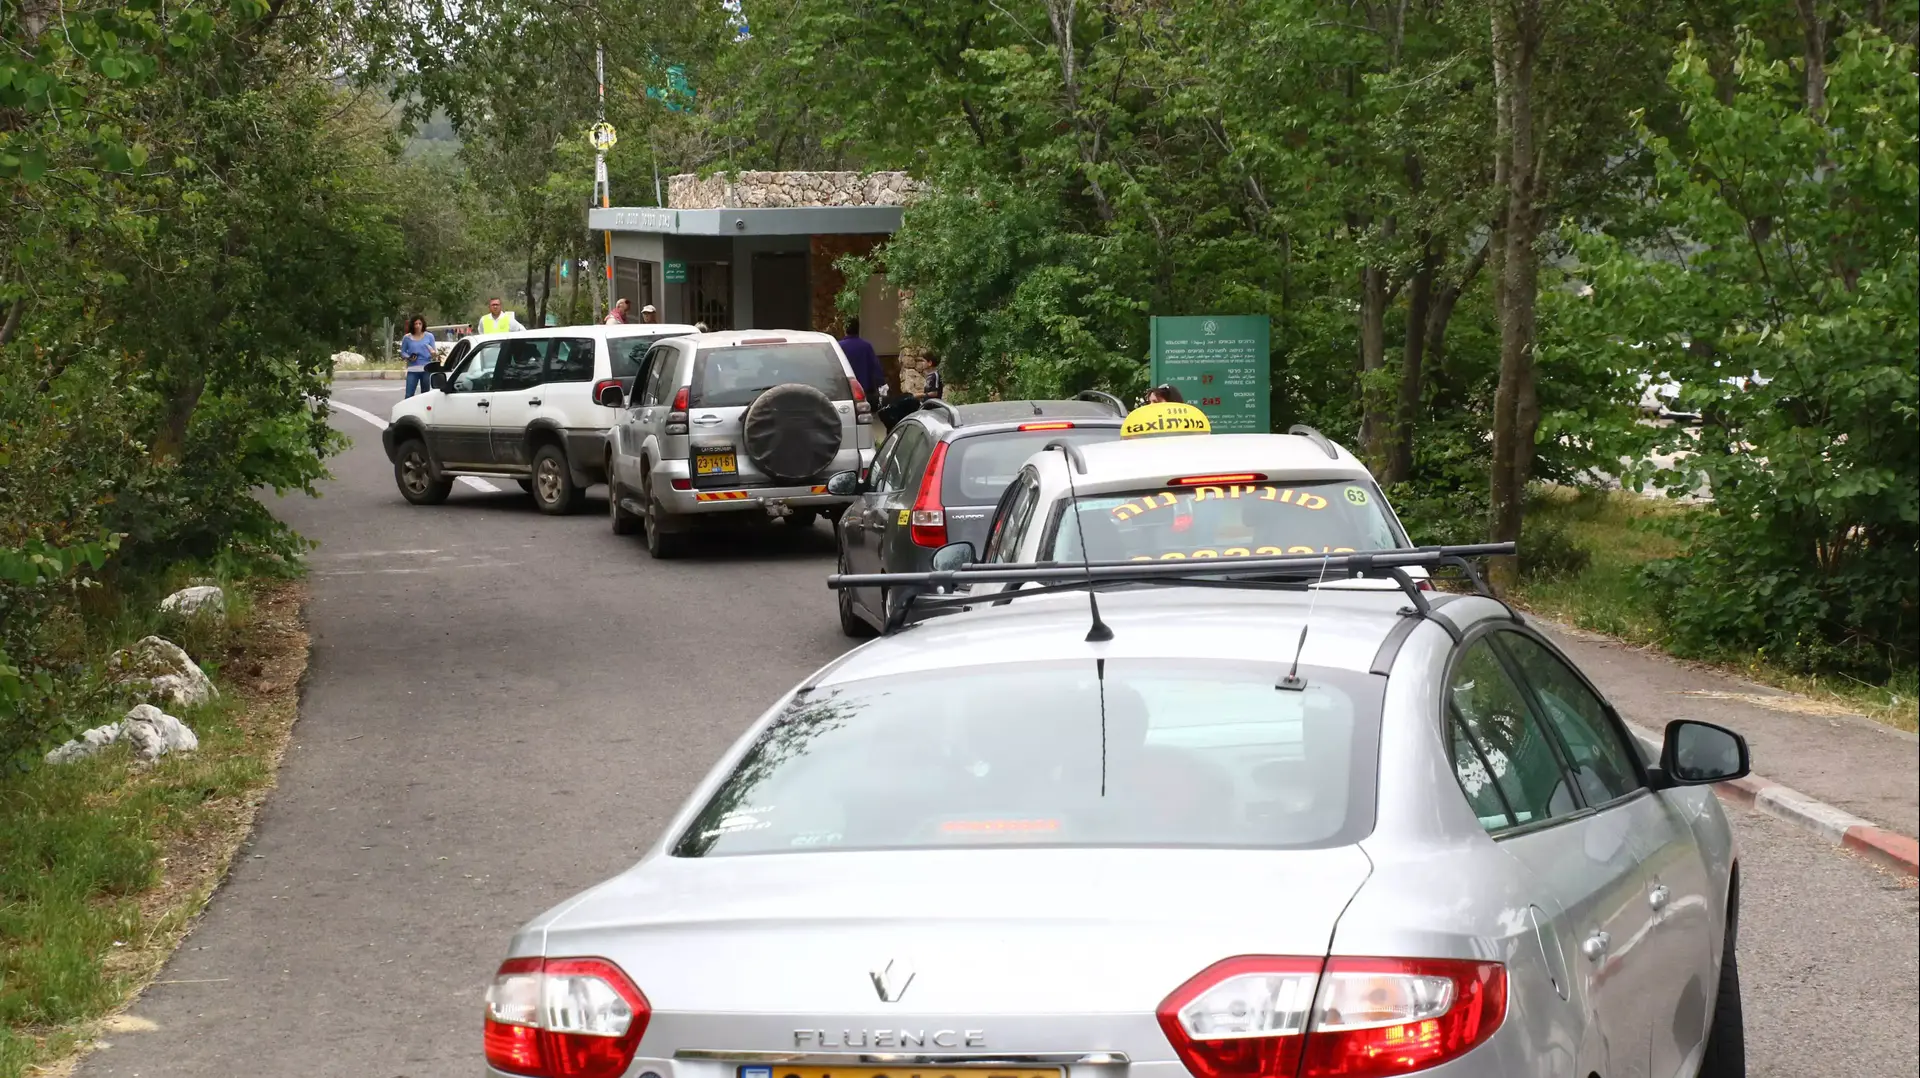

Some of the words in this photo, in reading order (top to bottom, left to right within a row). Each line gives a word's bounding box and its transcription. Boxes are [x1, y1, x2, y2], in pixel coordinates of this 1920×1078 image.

[1126, 414, 1164, 433] taxi
[1166, 418, 1204, 430] מונית
[1194, 485, 1328, 510] מוניות
[1347, 489, 1366, 503] 63
[1112, 491, 1178, 521] נוה
[793, 1029, 987, 1048] FLUENCE
